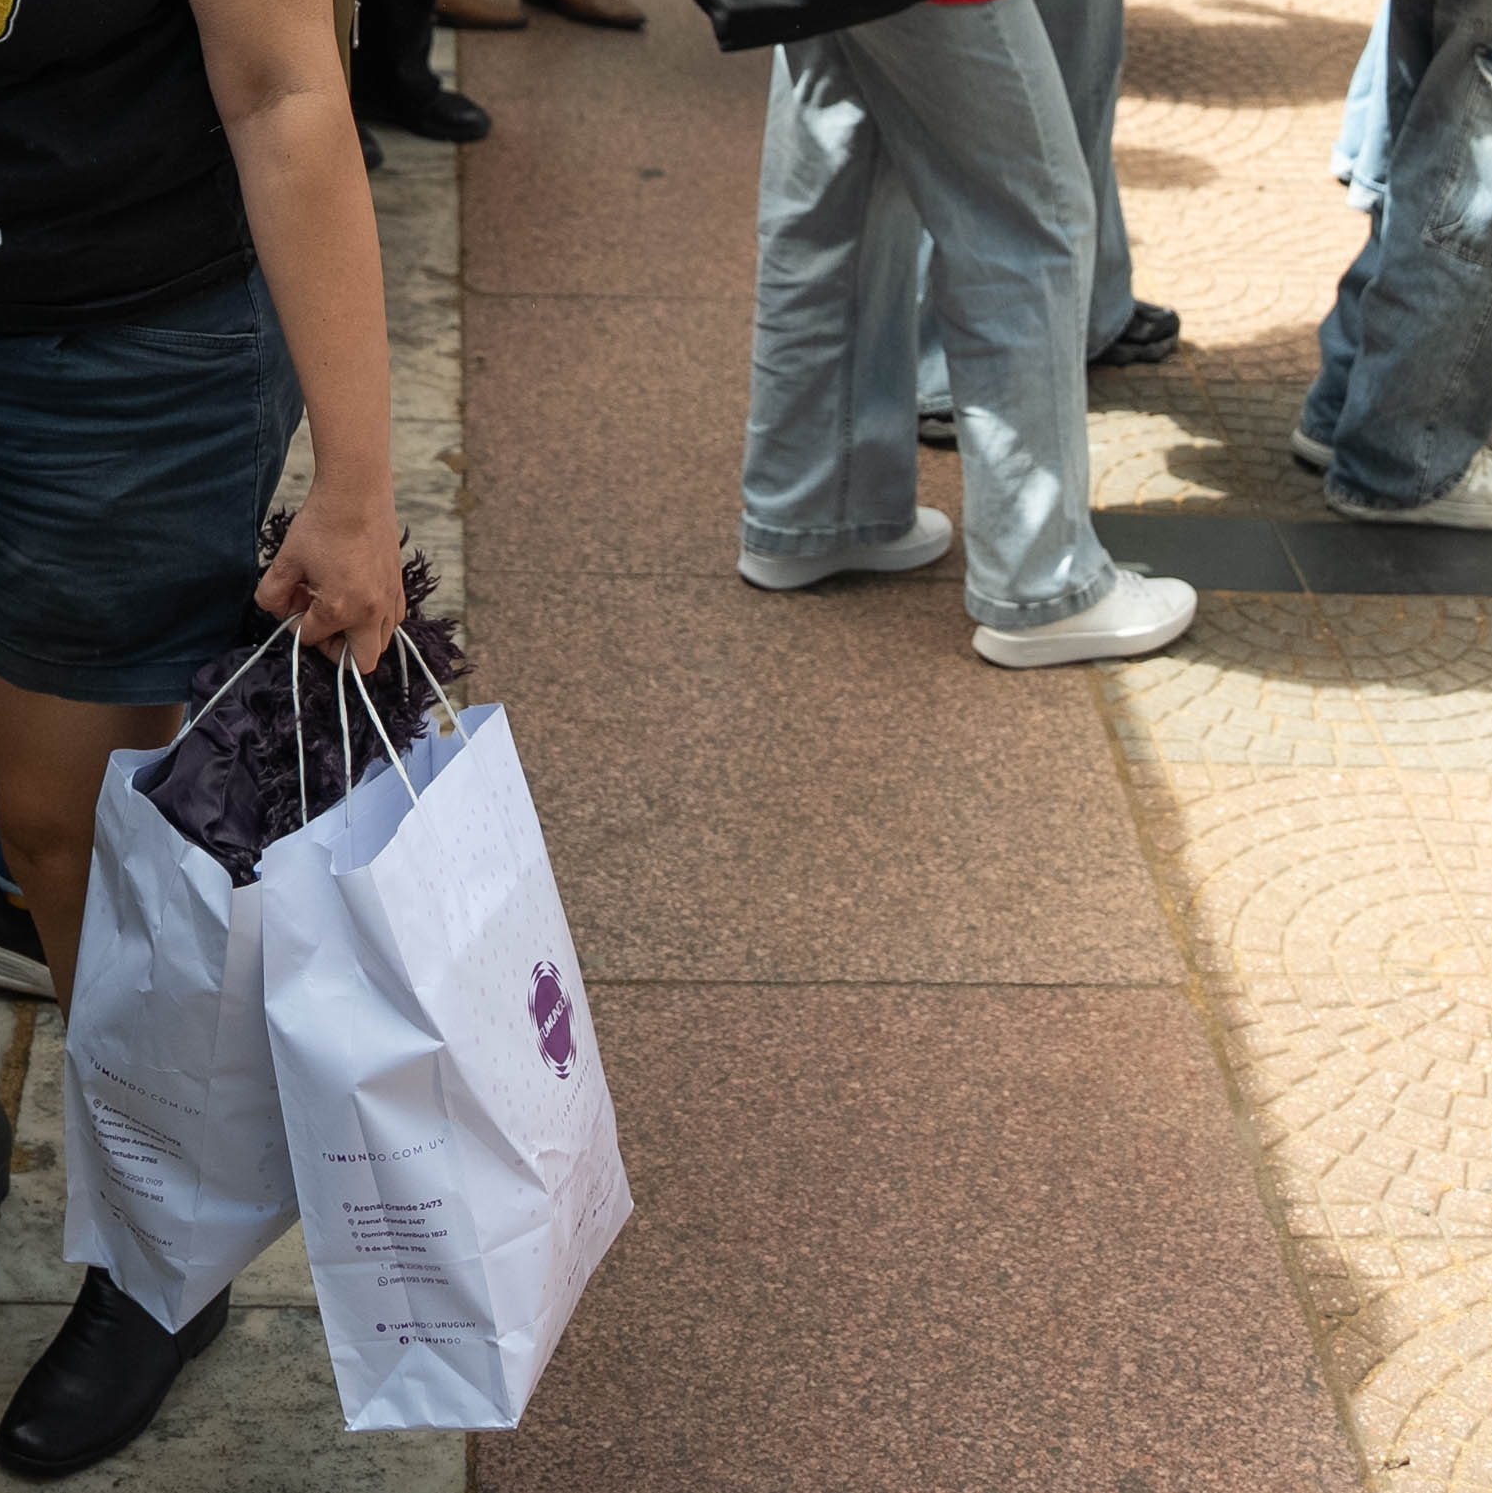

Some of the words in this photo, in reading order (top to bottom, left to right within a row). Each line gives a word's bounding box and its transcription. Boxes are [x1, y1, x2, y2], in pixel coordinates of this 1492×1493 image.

[539, 994, 567, 1043] TUMUNDO
[98, 1130, 131, 1143] Domingo
[111, 1150, 140, 1161] octubre
[354, 1201, 384, 1212] Arenal
[385, 1203, 418, 1212] Grande
[419, 1198, 443, 1211] 2473
[357, 1217, 382, 1226] Arenal
[383, 1216, 407, 1224] Grande
[361, 1231, 394, 1239] Domingo
[389, 1321, 476, 1331] TUMUNDO.URUGUAY
[412, 1336, 462, 1345] TUMUNDO
